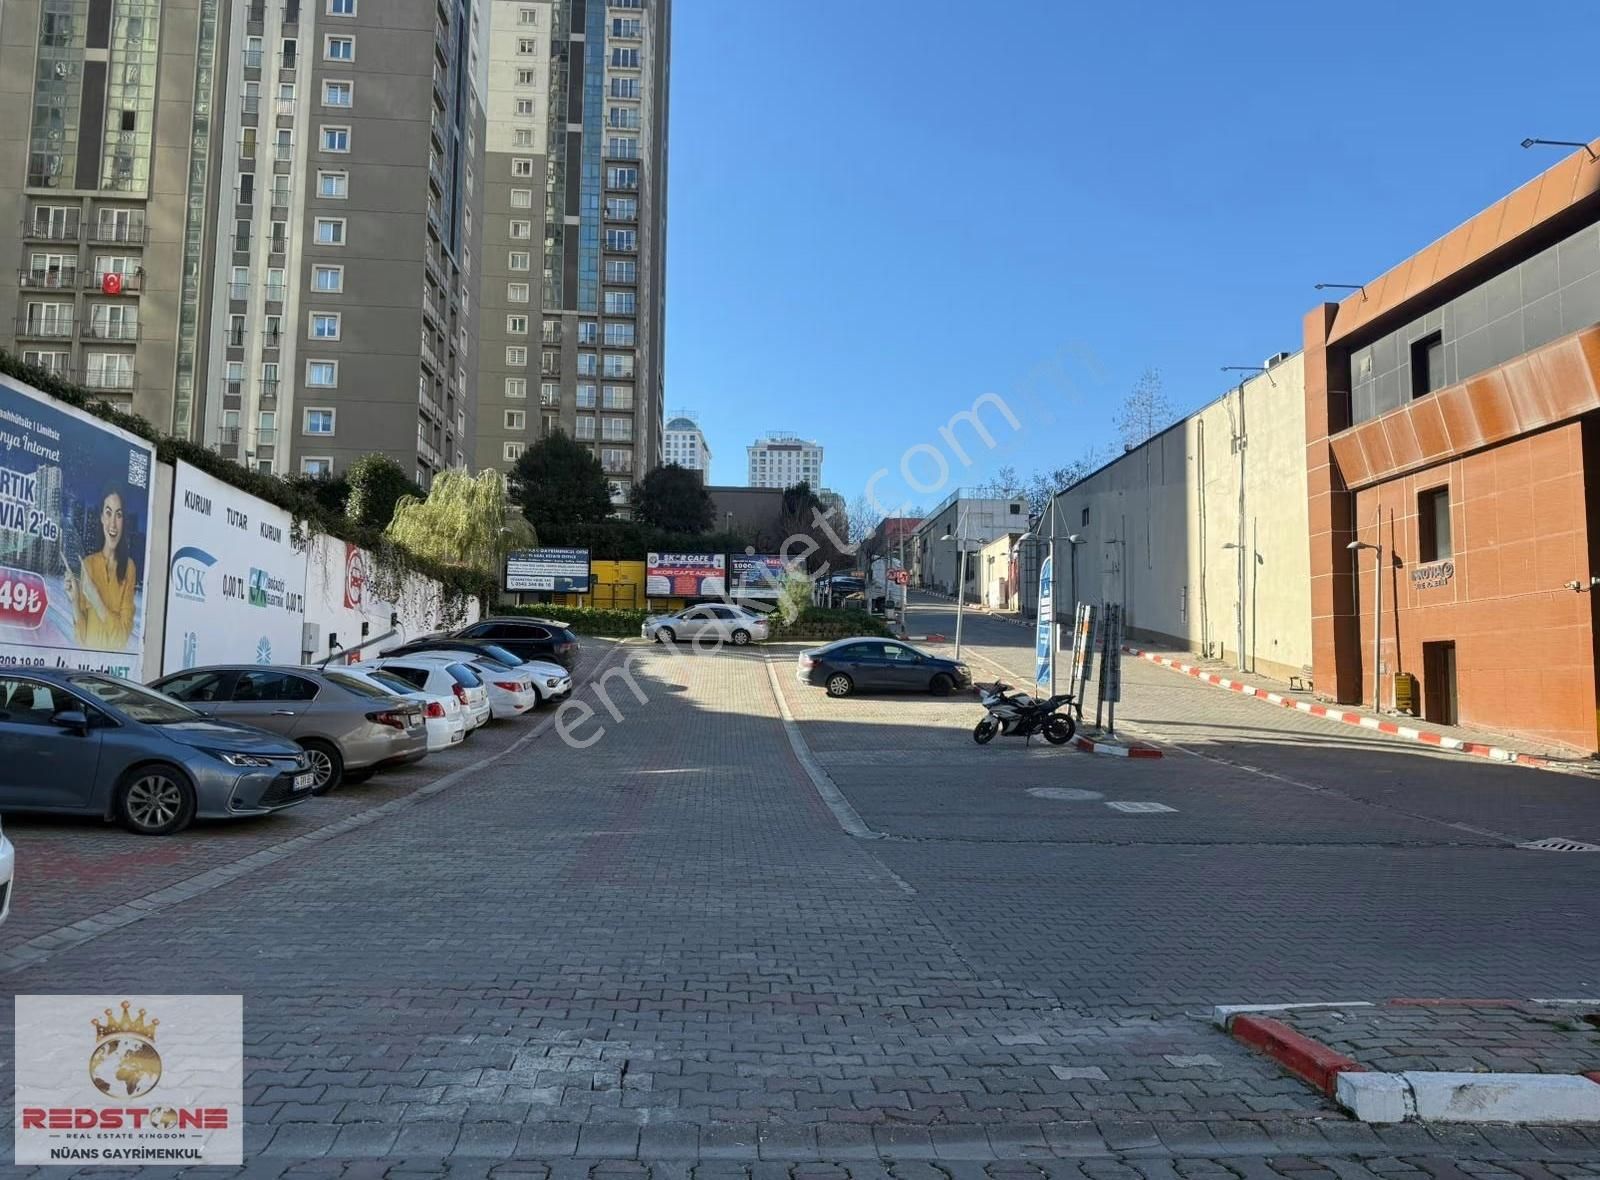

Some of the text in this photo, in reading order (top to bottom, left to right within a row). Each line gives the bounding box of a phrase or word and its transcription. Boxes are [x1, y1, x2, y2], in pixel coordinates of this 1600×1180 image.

[185, 489, 212, 516] KURUM
[227, 507, 248, 531] TUTAR
[260, 521, 282, 544] KURUM
[687, 554, 710, 562] CAFE
[175, 563, 207, 597] SGK
[222, 574, 245, 600] 0,00 TL
[297, 594, 304, 614] TL
